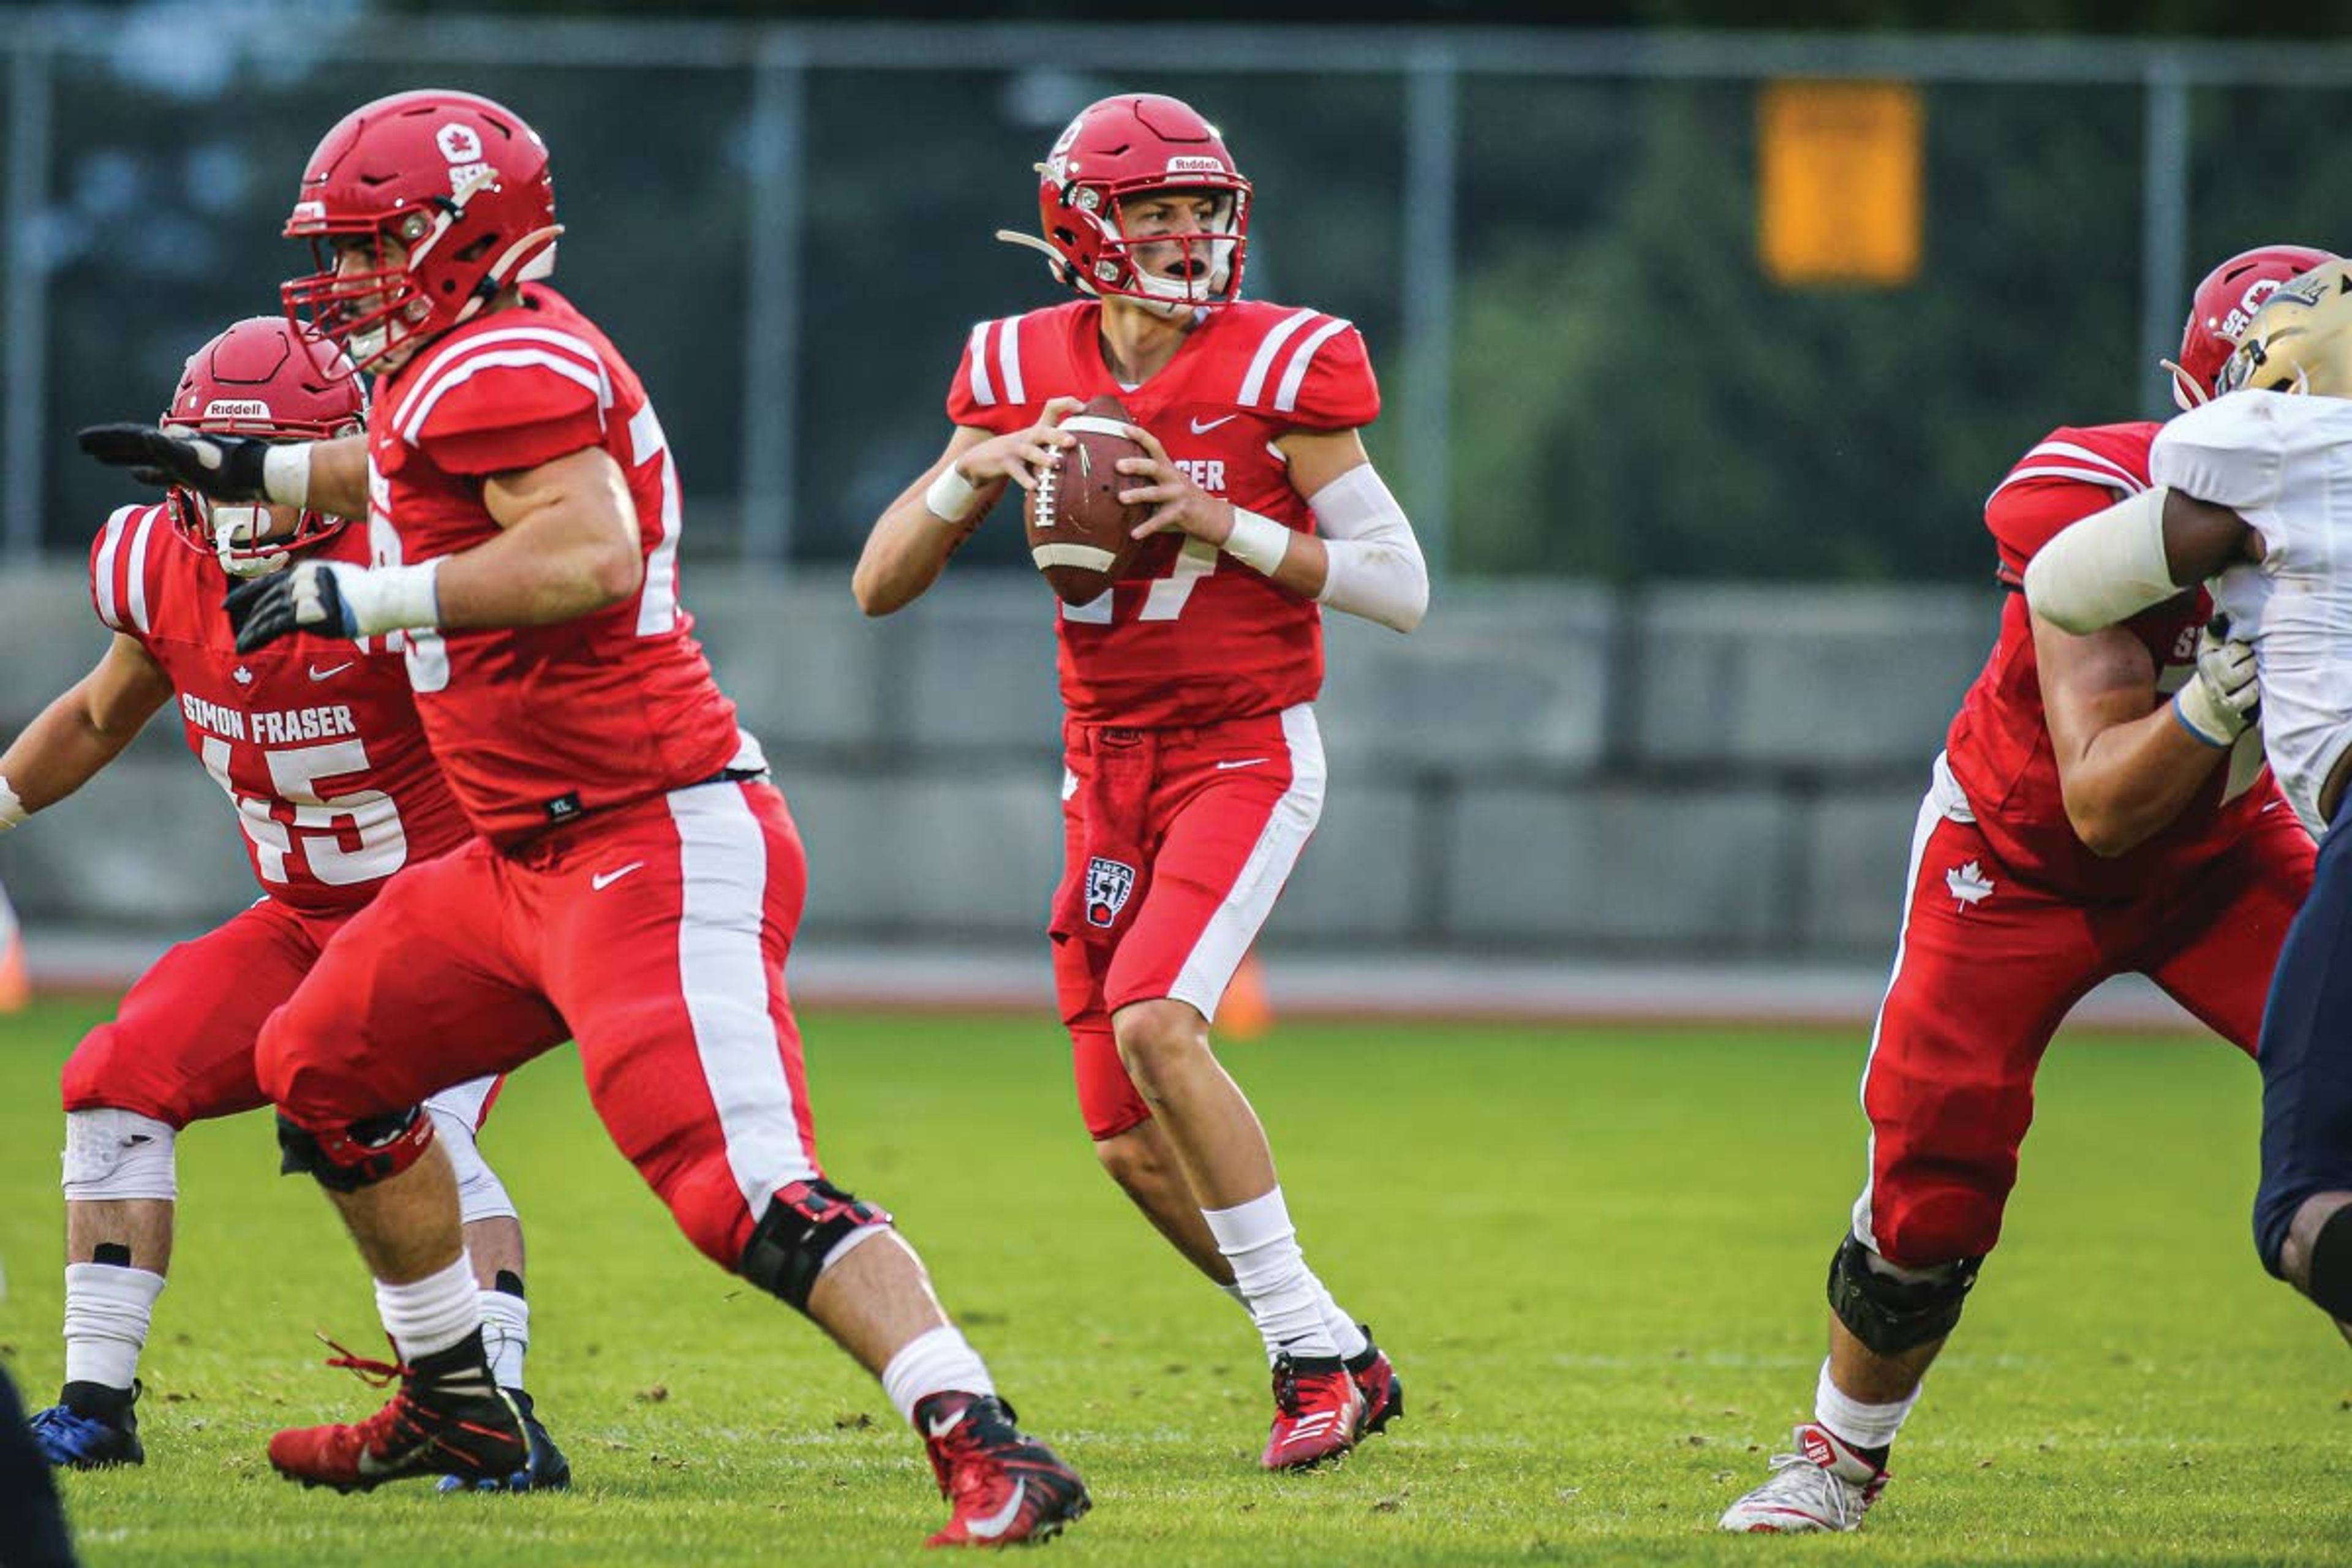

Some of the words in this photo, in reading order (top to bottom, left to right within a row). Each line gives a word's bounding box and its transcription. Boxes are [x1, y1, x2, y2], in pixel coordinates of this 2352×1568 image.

[1175, 159, 1218, 170] Riddell
[211, 404, 261, 415] Riddell
[1063, 497, 1227, 624] 7
[182, 693, 244, 740] SIMON
[251, 706, 356, 744] FRASER
[202, 735, 407, 886] 45
